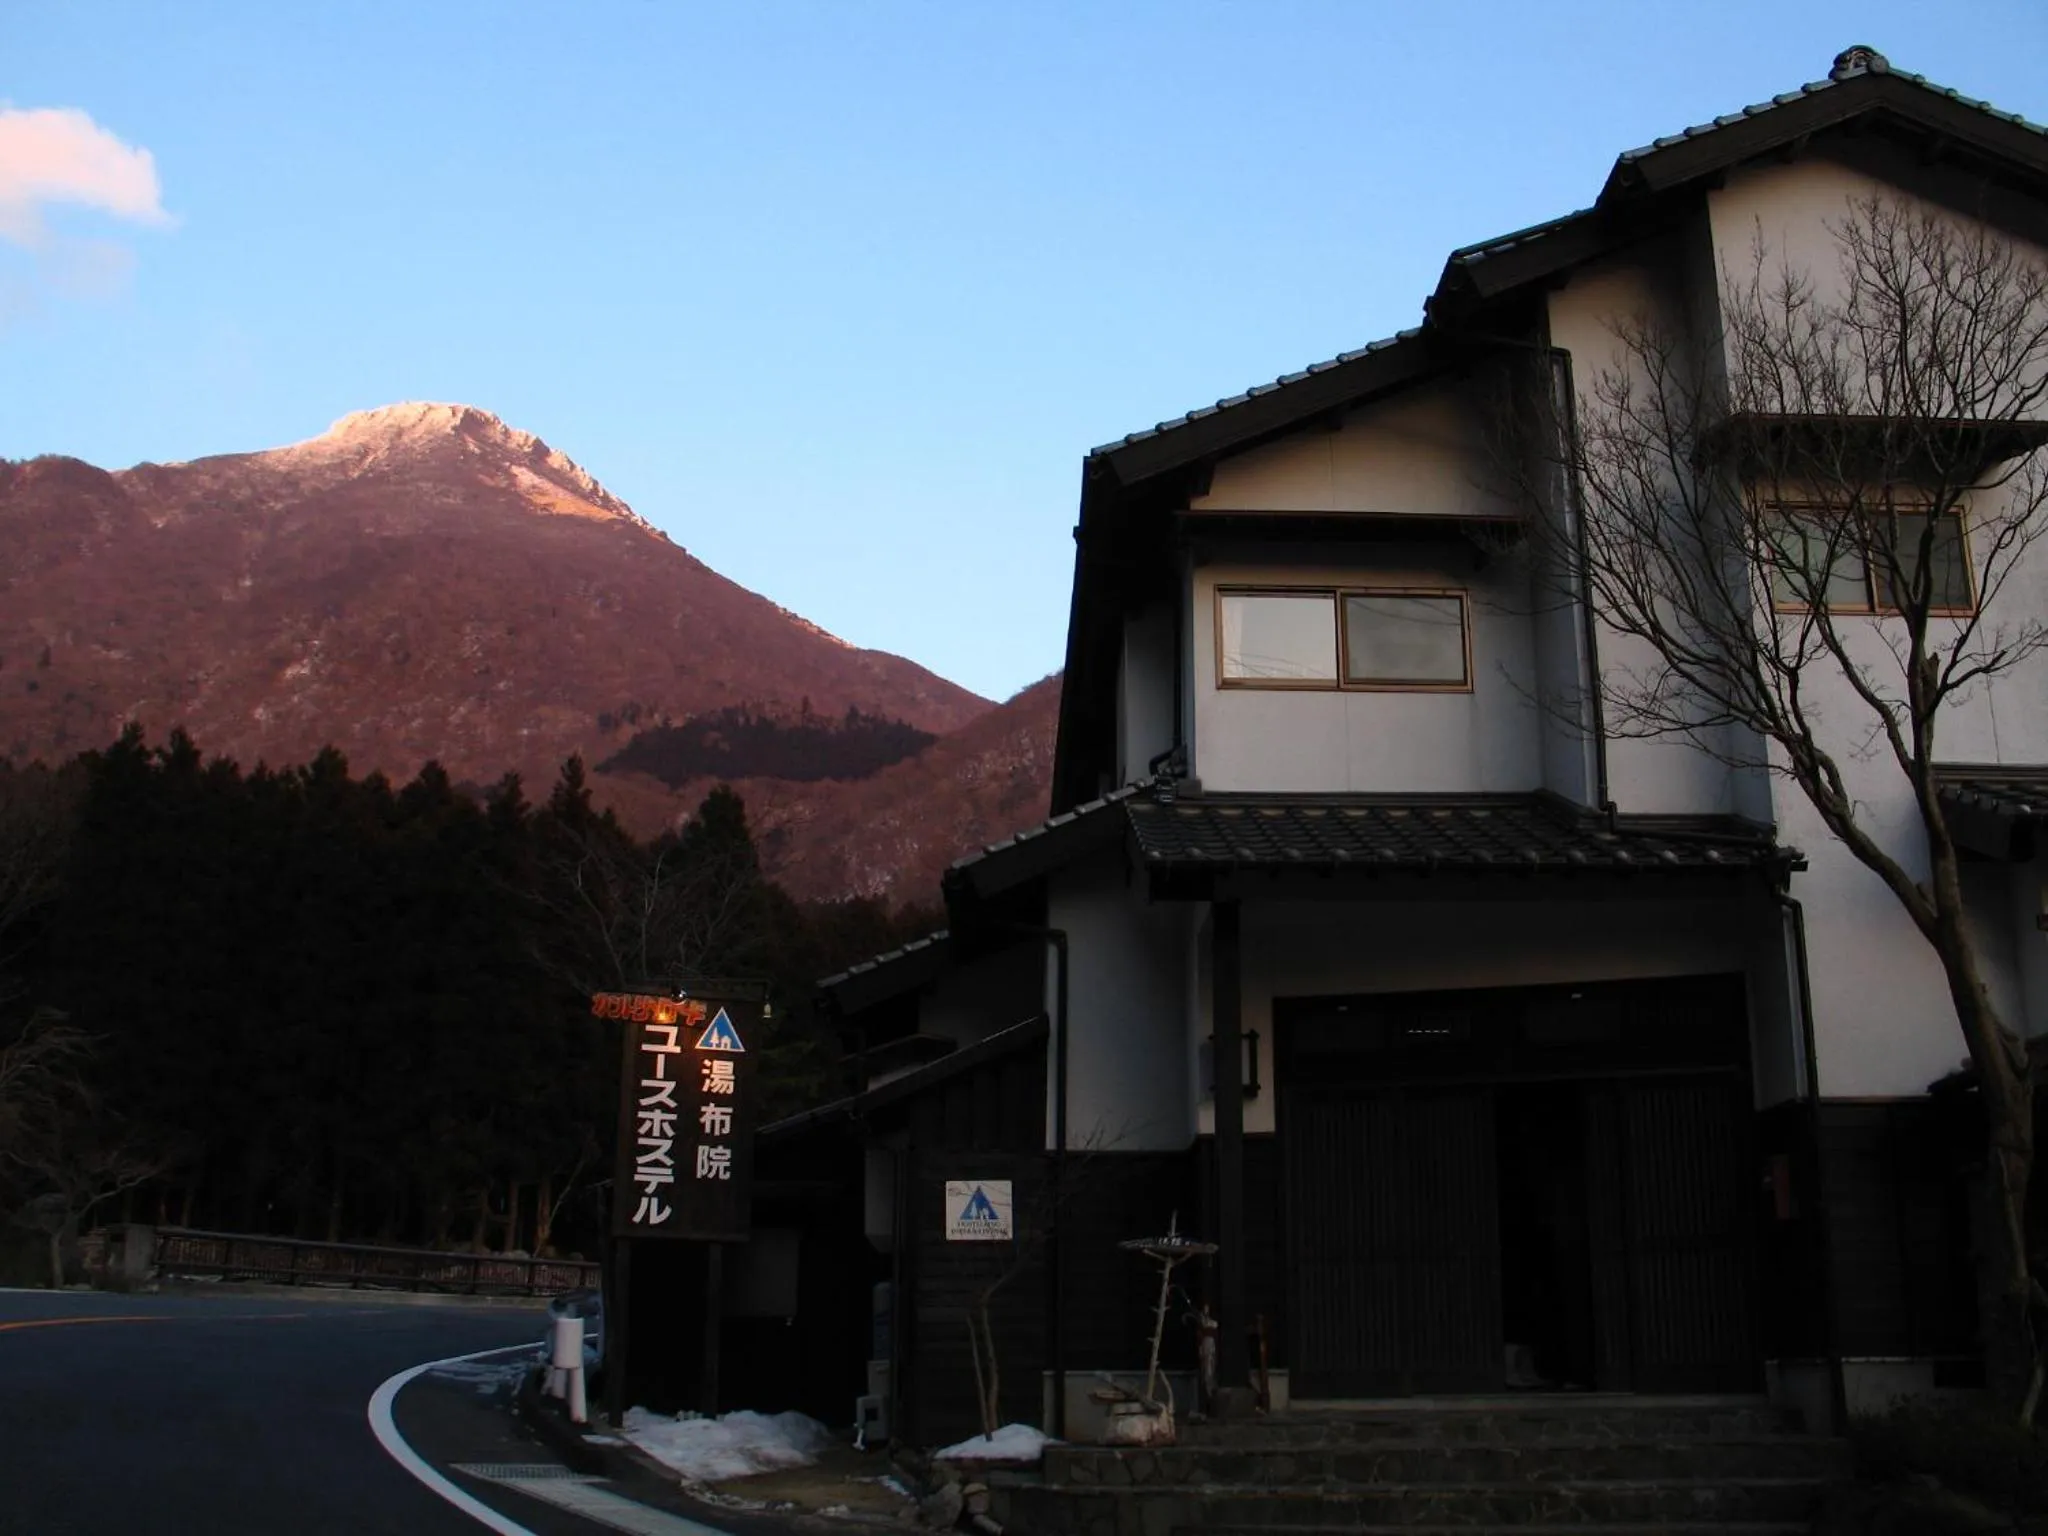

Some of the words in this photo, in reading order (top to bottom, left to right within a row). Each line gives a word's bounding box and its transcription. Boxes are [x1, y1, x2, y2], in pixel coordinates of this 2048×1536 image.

[631, 1024, 682, 1225] ユースホステル
[696, 1058, 736, 1181] 湯布院
